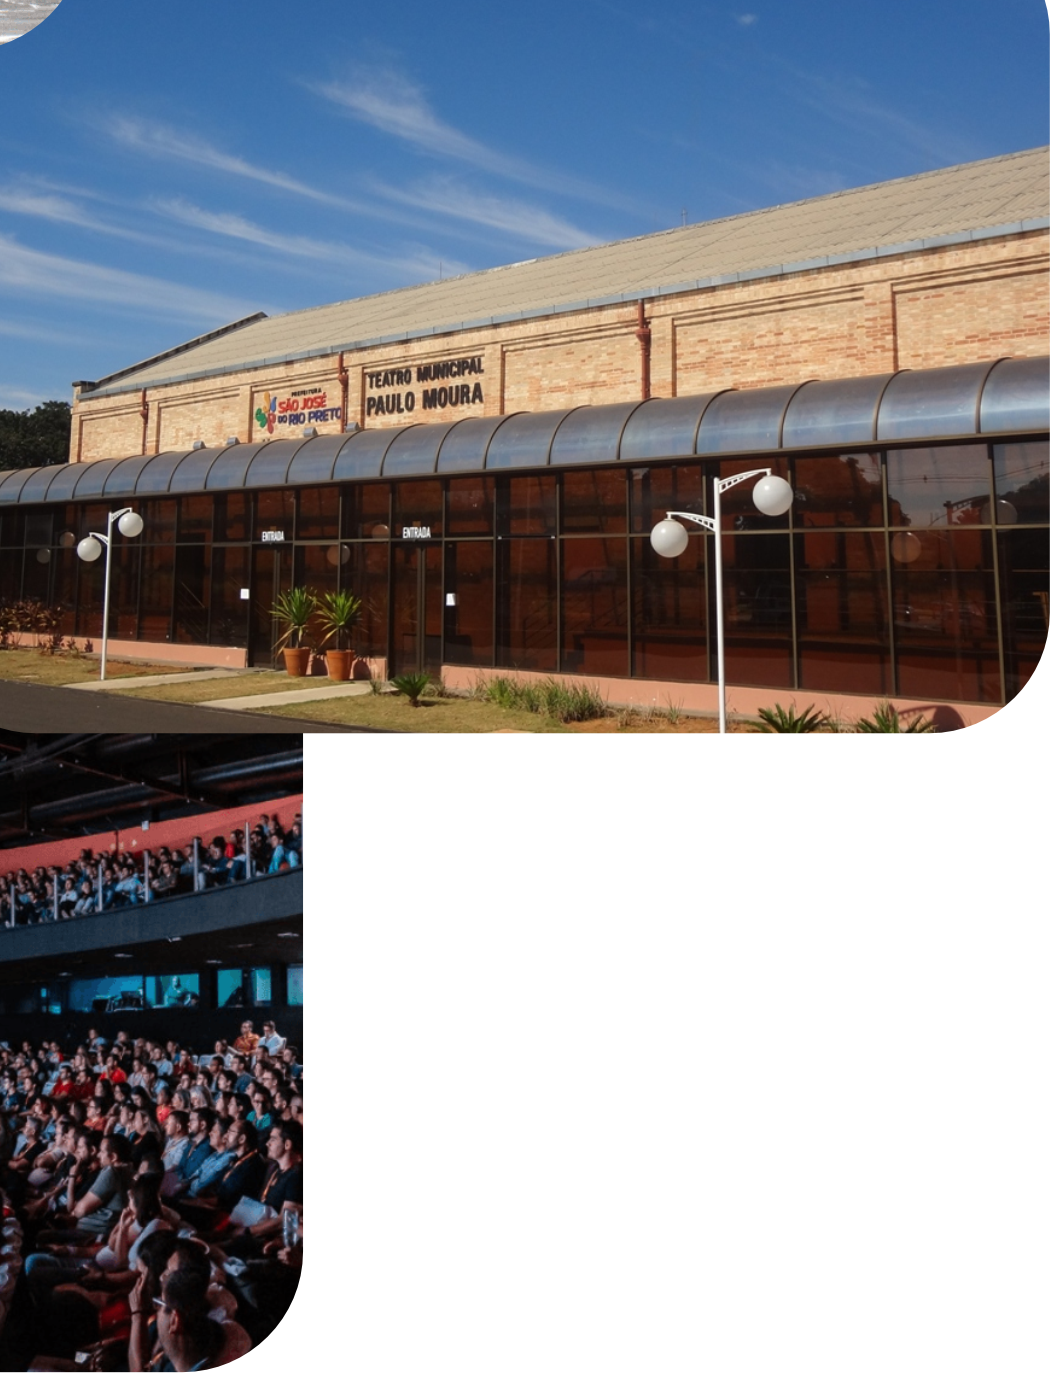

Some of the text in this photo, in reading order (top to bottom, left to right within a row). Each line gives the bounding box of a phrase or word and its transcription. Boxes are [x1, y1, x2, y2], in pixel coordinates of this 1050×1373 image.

[368, 358, 484, 389] TEATRO MUNICIPAL
[291, 388, 322, 397] PREFEITURA
[366, 382, 484, 417] PAULO MOURA
[278, 392, 327, 414] SÃO JOSÉ
[277, 407, 342, 426] DO RIO PRETO
[262, 531, 285, 542] ENTRADA
[403, 527, 431, 538] ENTRADA
